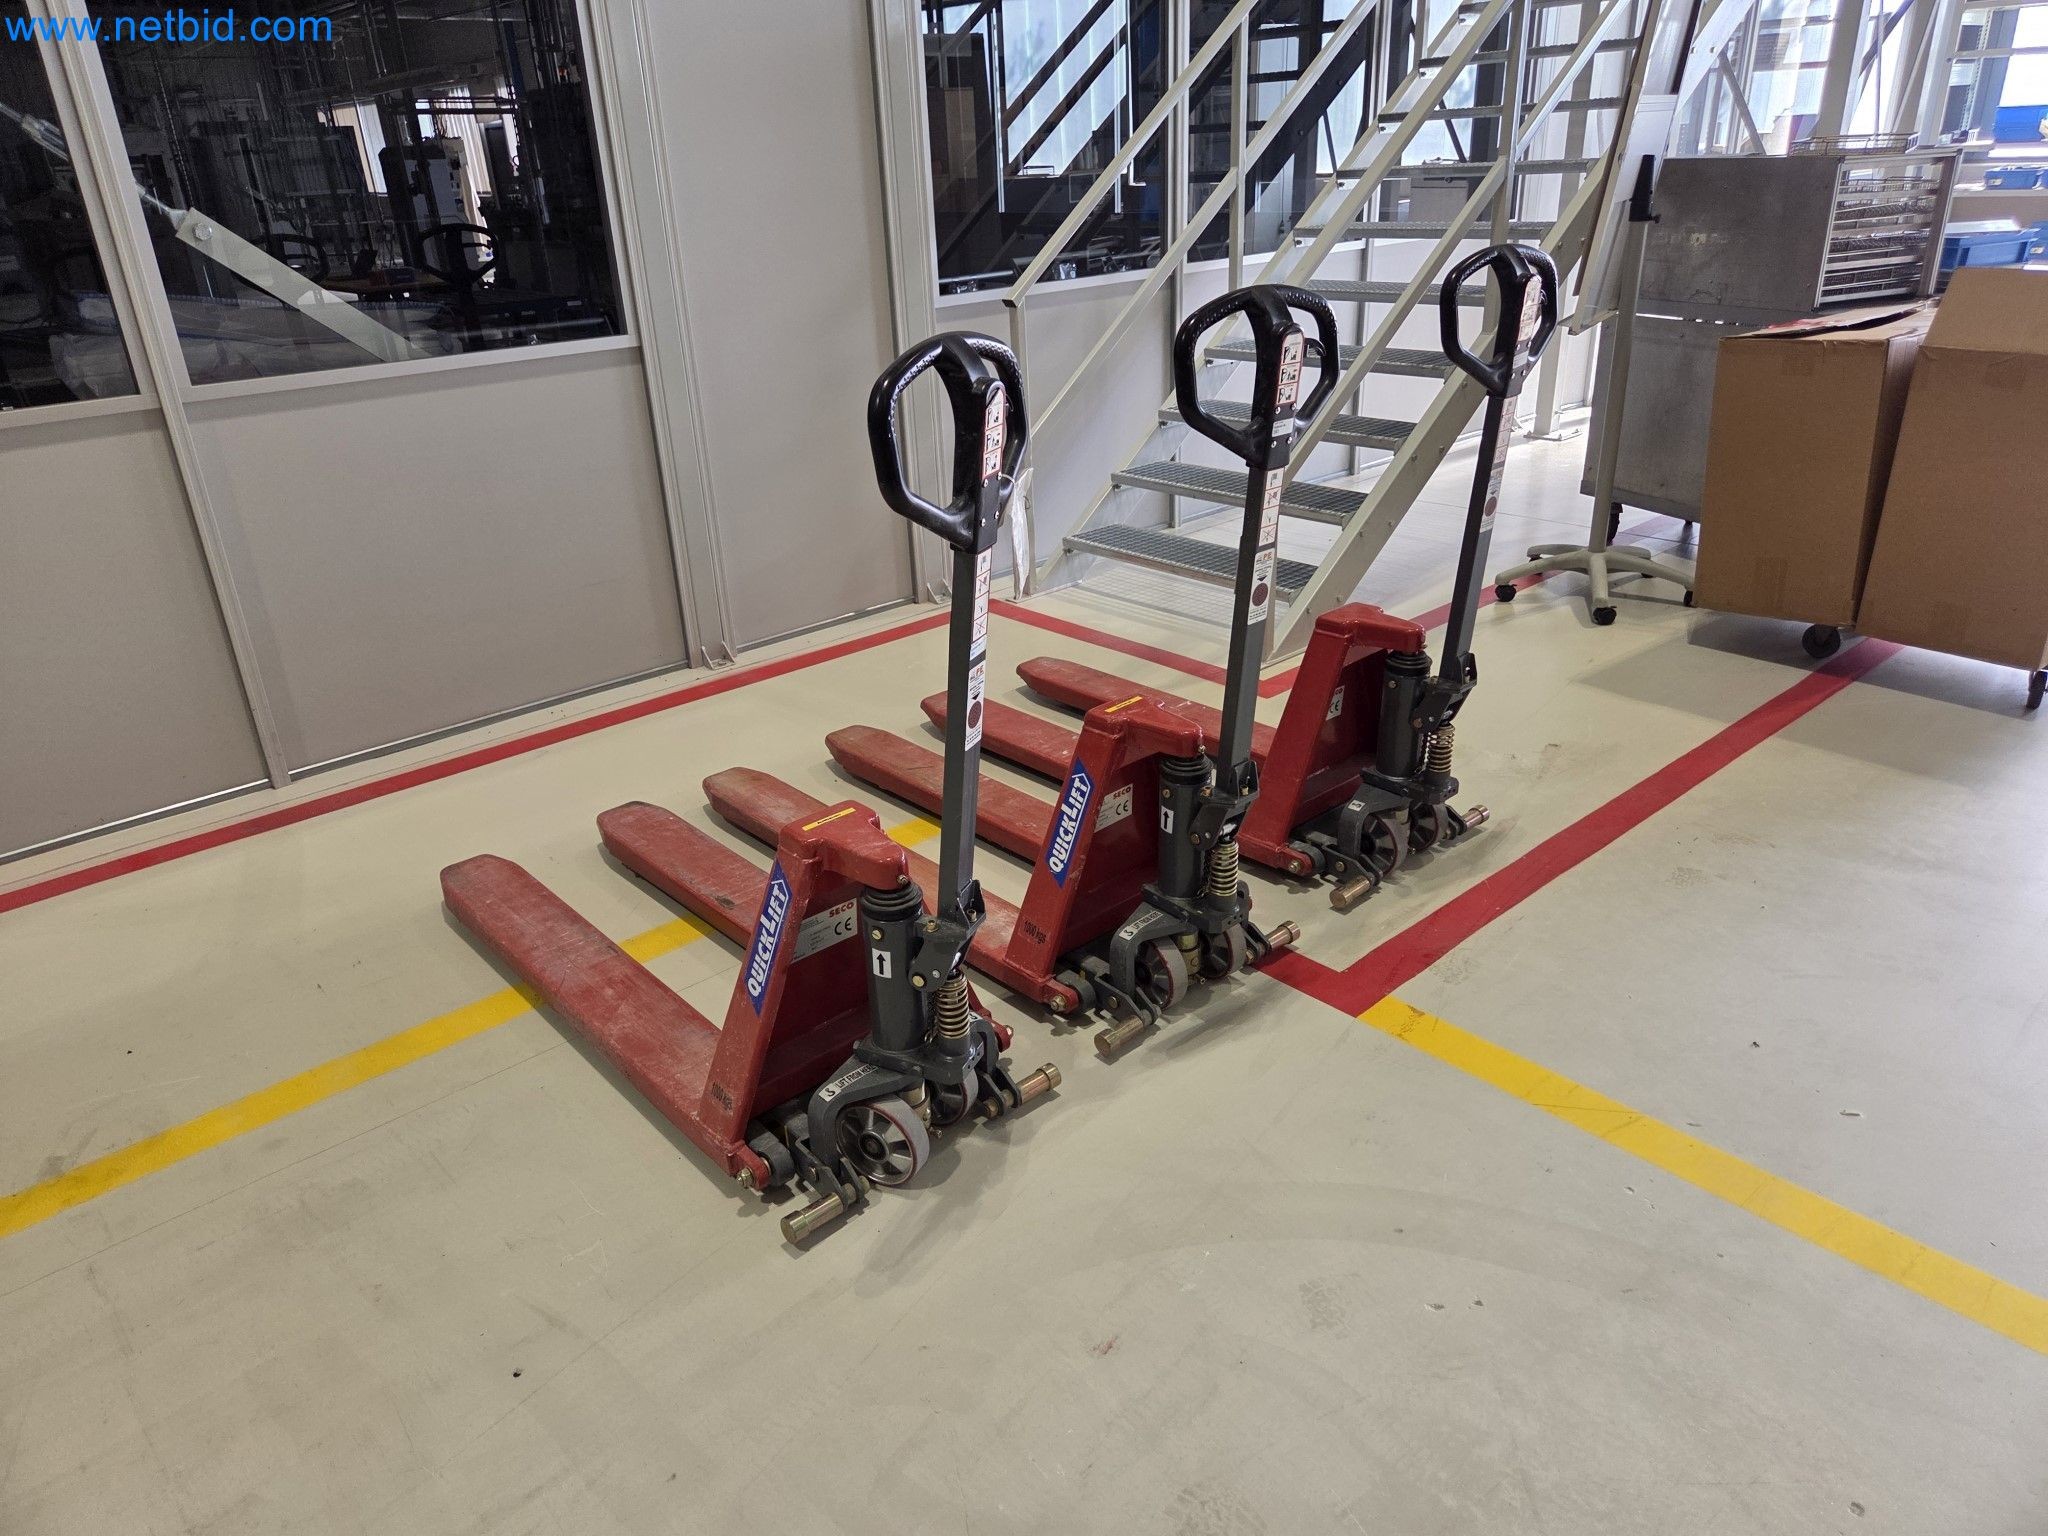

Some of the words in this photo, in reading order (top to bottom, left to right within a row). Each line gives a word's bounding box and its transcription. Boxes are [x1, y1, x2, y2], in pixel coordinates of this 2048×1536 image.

[1113, 786, 1131, 800] SECO
[1048, 778, 1088, 872] QUICKLIFT
[829, 901, 855, 918] SECO
[834, 917, 852, 935] CE
[747, 884, 786, 998] QUICKLIFT
[835, 1077, 848, 1088] LIFT
[846, 1070, 863, 1082] FROM
